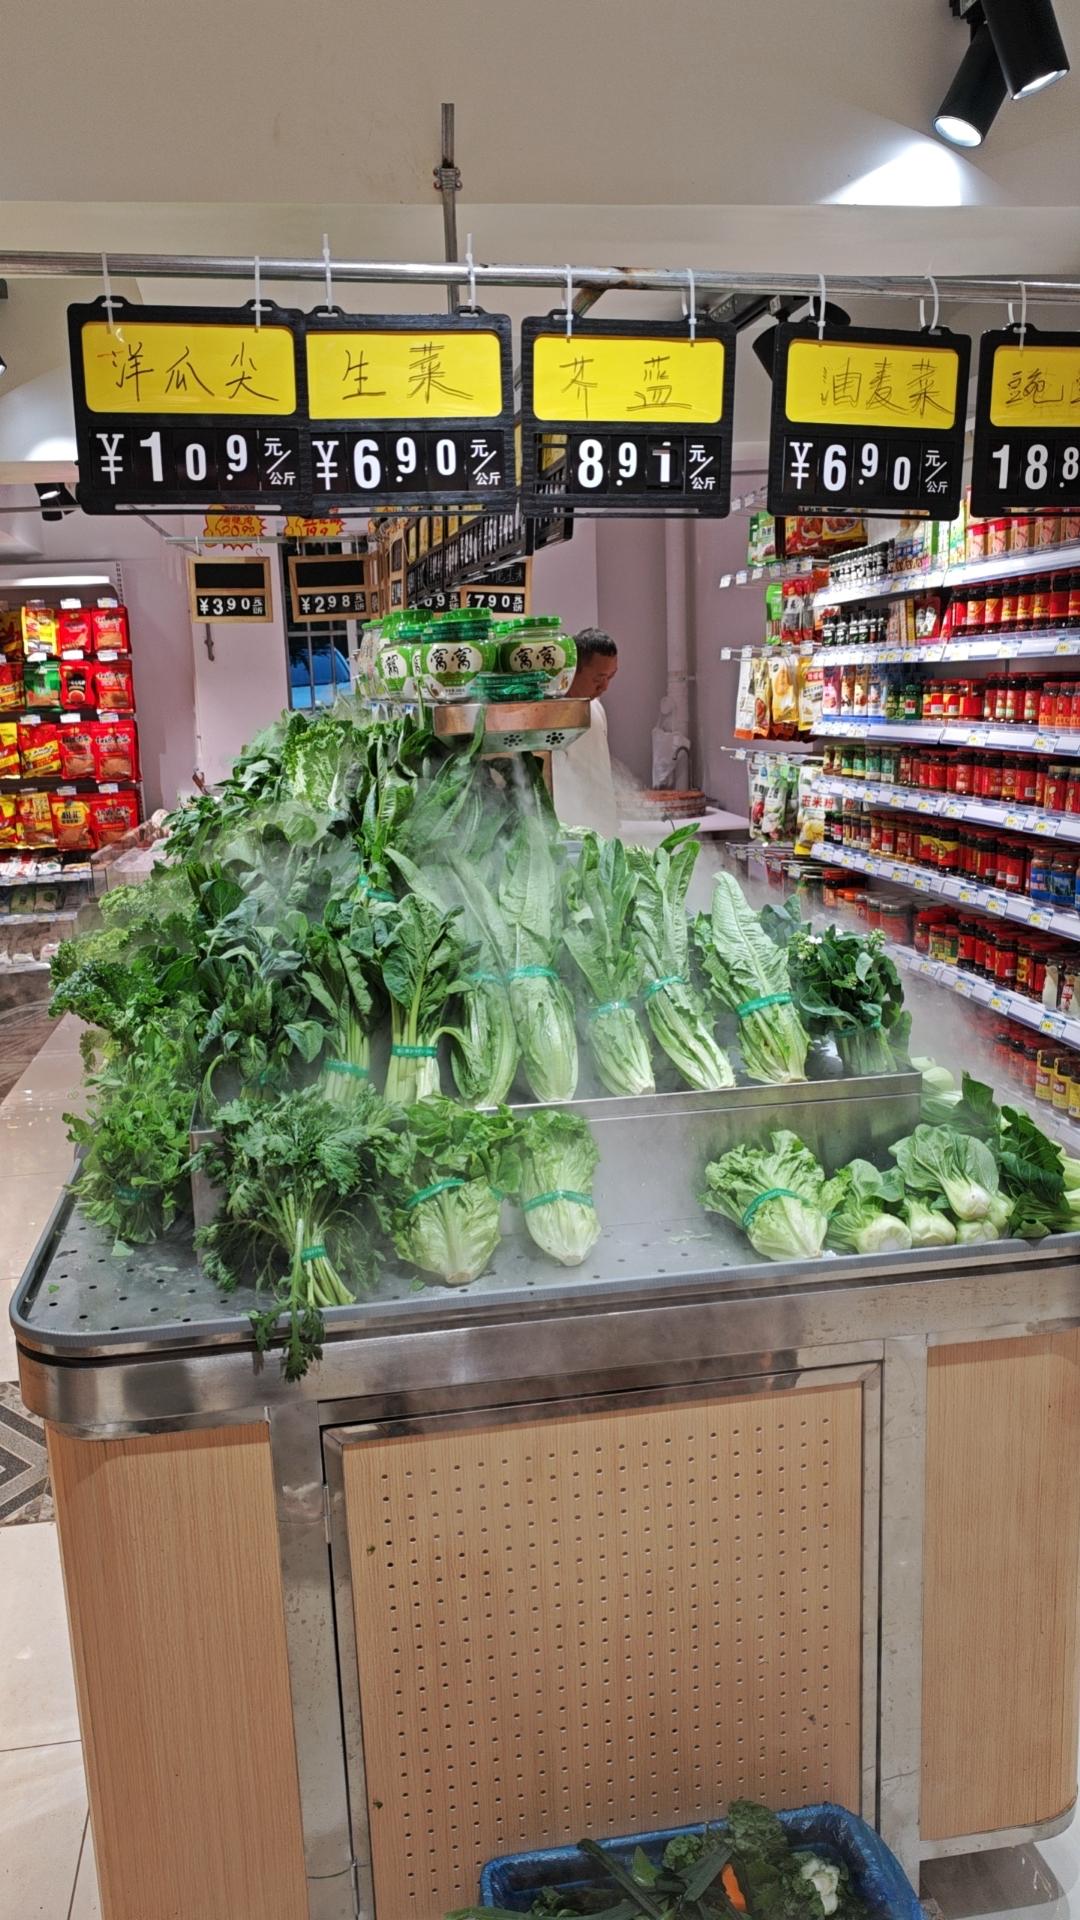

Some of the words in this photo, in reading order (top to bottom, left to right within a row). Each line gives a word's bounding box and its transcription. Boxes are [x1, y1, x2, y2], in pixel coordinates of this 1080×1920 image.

[110, 341, 280, 402] 洋瓜尖
[342, 341, 474, 404] 生菜
[820, 356, 955, 417] 油麦菜
